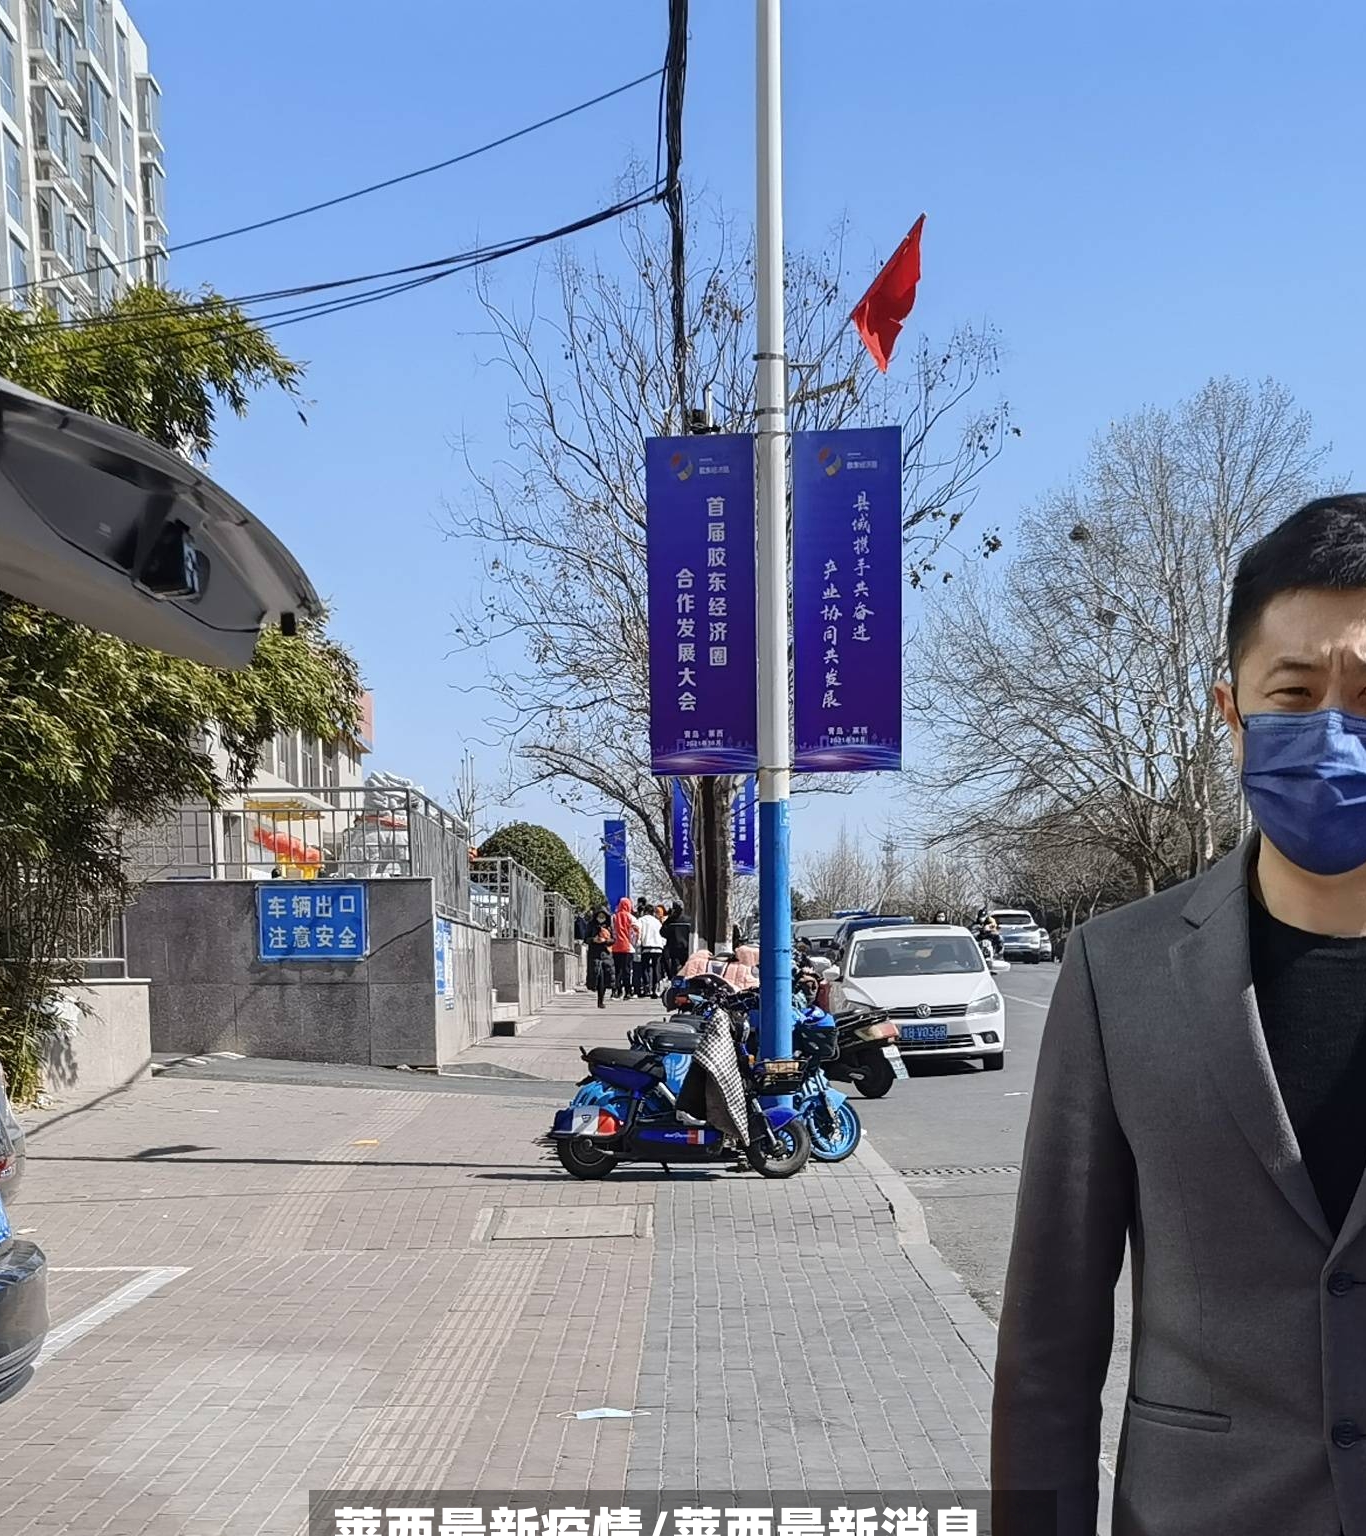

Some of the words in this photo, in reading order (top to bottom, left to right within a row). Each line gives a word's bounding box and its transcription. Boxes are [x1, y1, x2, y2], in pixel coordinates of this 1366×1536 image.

[675, 568, 697, 712] 合作发展大会
[706, 497, 728, 667] 首届胶东经济圈
[819, 558, 842, 709] 产业协同共发展
[267, 895, 357, 919] 车辆出口
[268, 925, 358, 949] 注意安全
